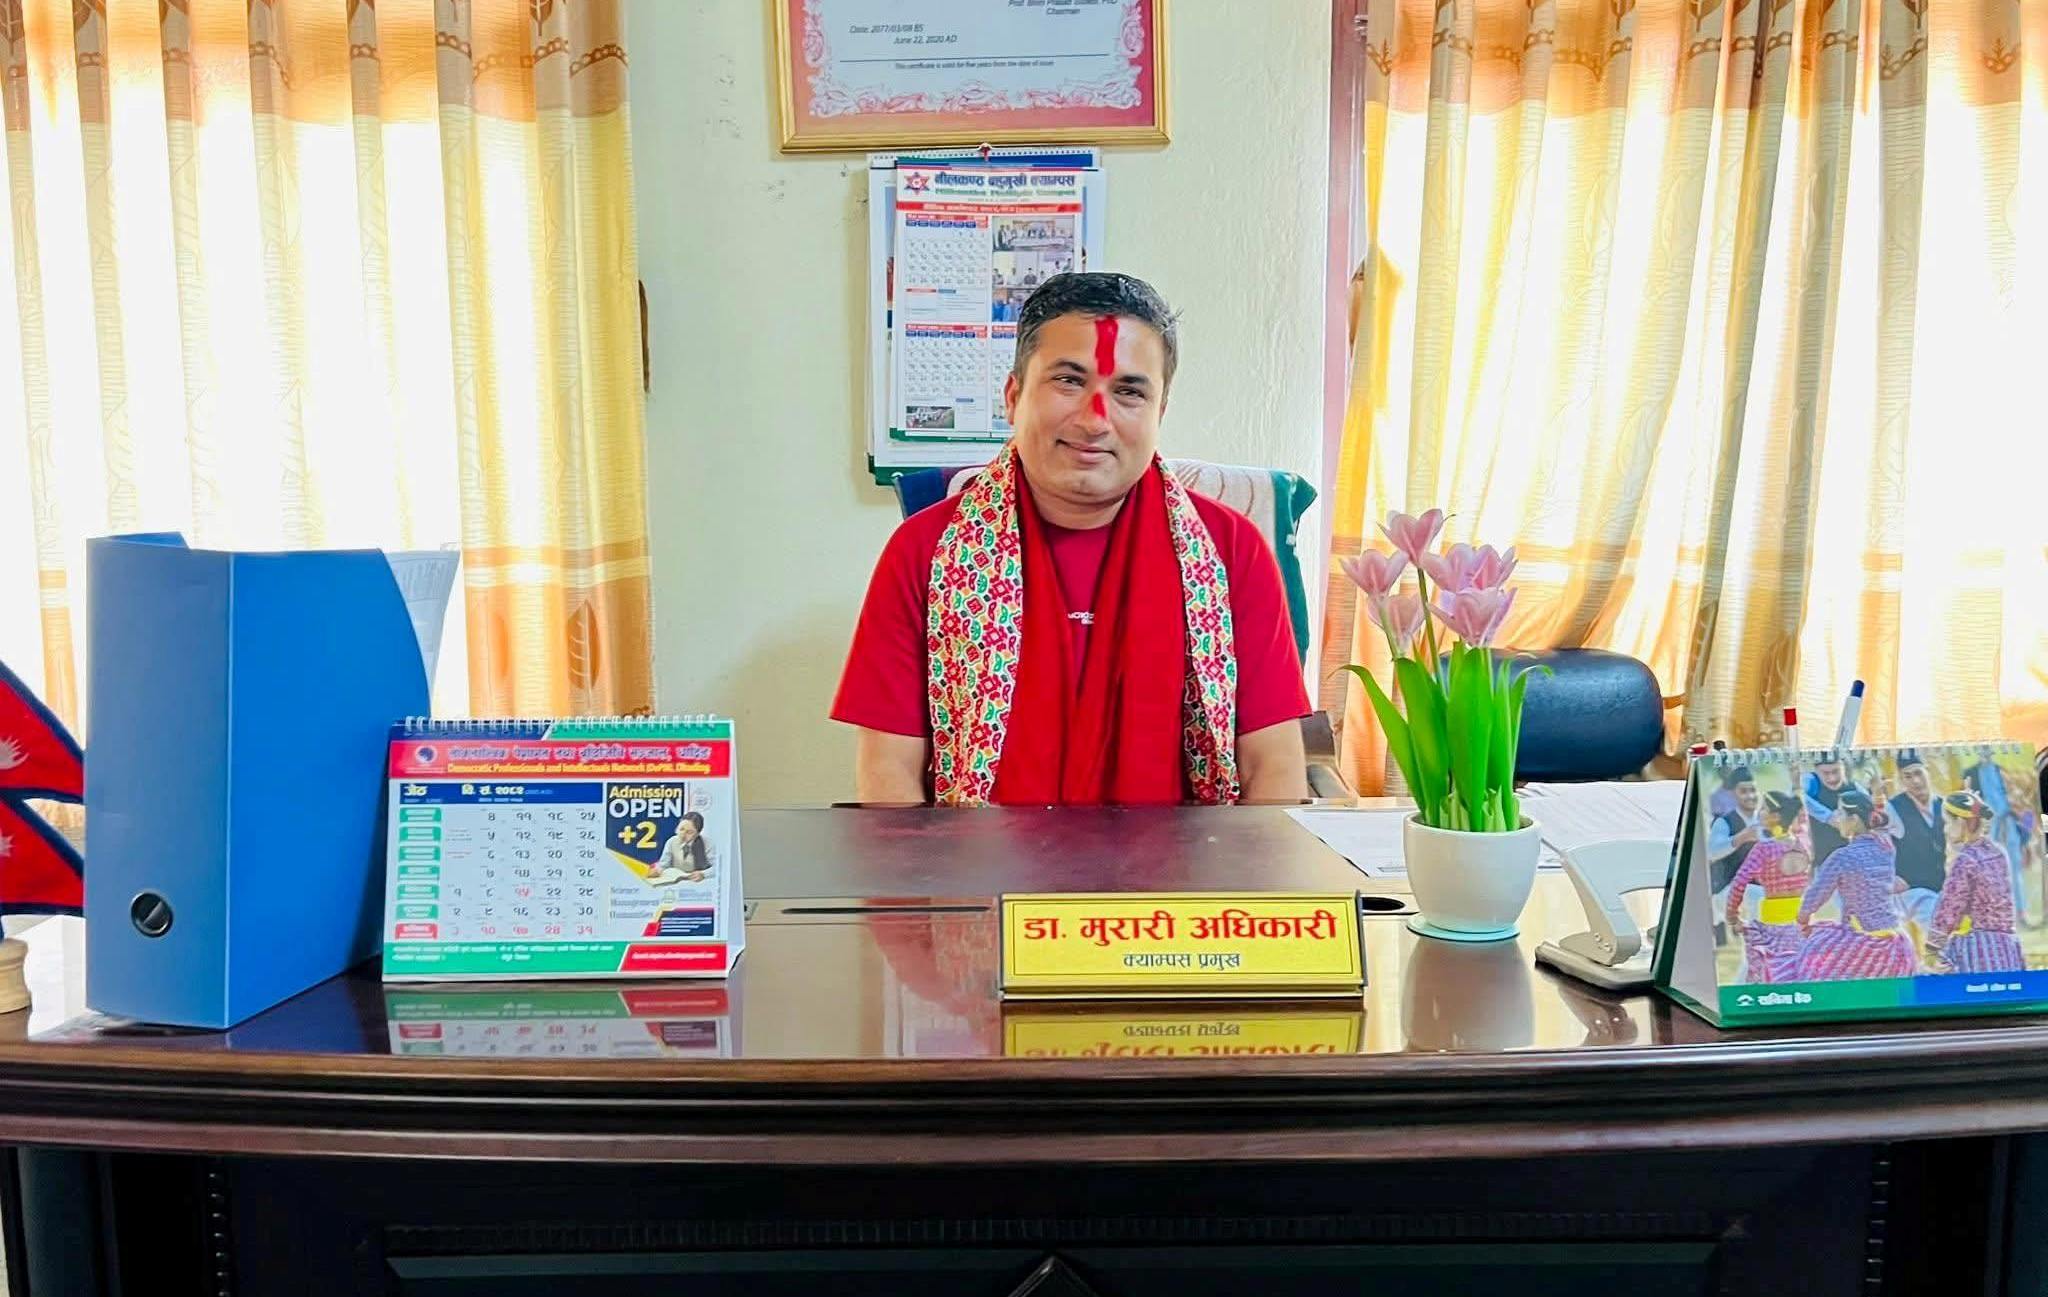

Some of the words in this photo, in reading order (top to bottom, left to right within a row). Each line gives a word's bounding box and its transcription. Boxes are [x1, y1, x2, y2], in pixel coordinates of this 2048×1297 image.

[609, 785, 682, 798] Admission
[608, 798, 682, 818] OPEN
[618, 821, 657, 849] +2
[1024, 917, 1067, 940] डा.
[1080, 910, 1175, 946] मुरारी
[1190, 909, 1337, 940] अधिकारी
[1123, 953, 1190, 968] क्याम्पस
[1198, 953, 1240, 971] प्रमुख
